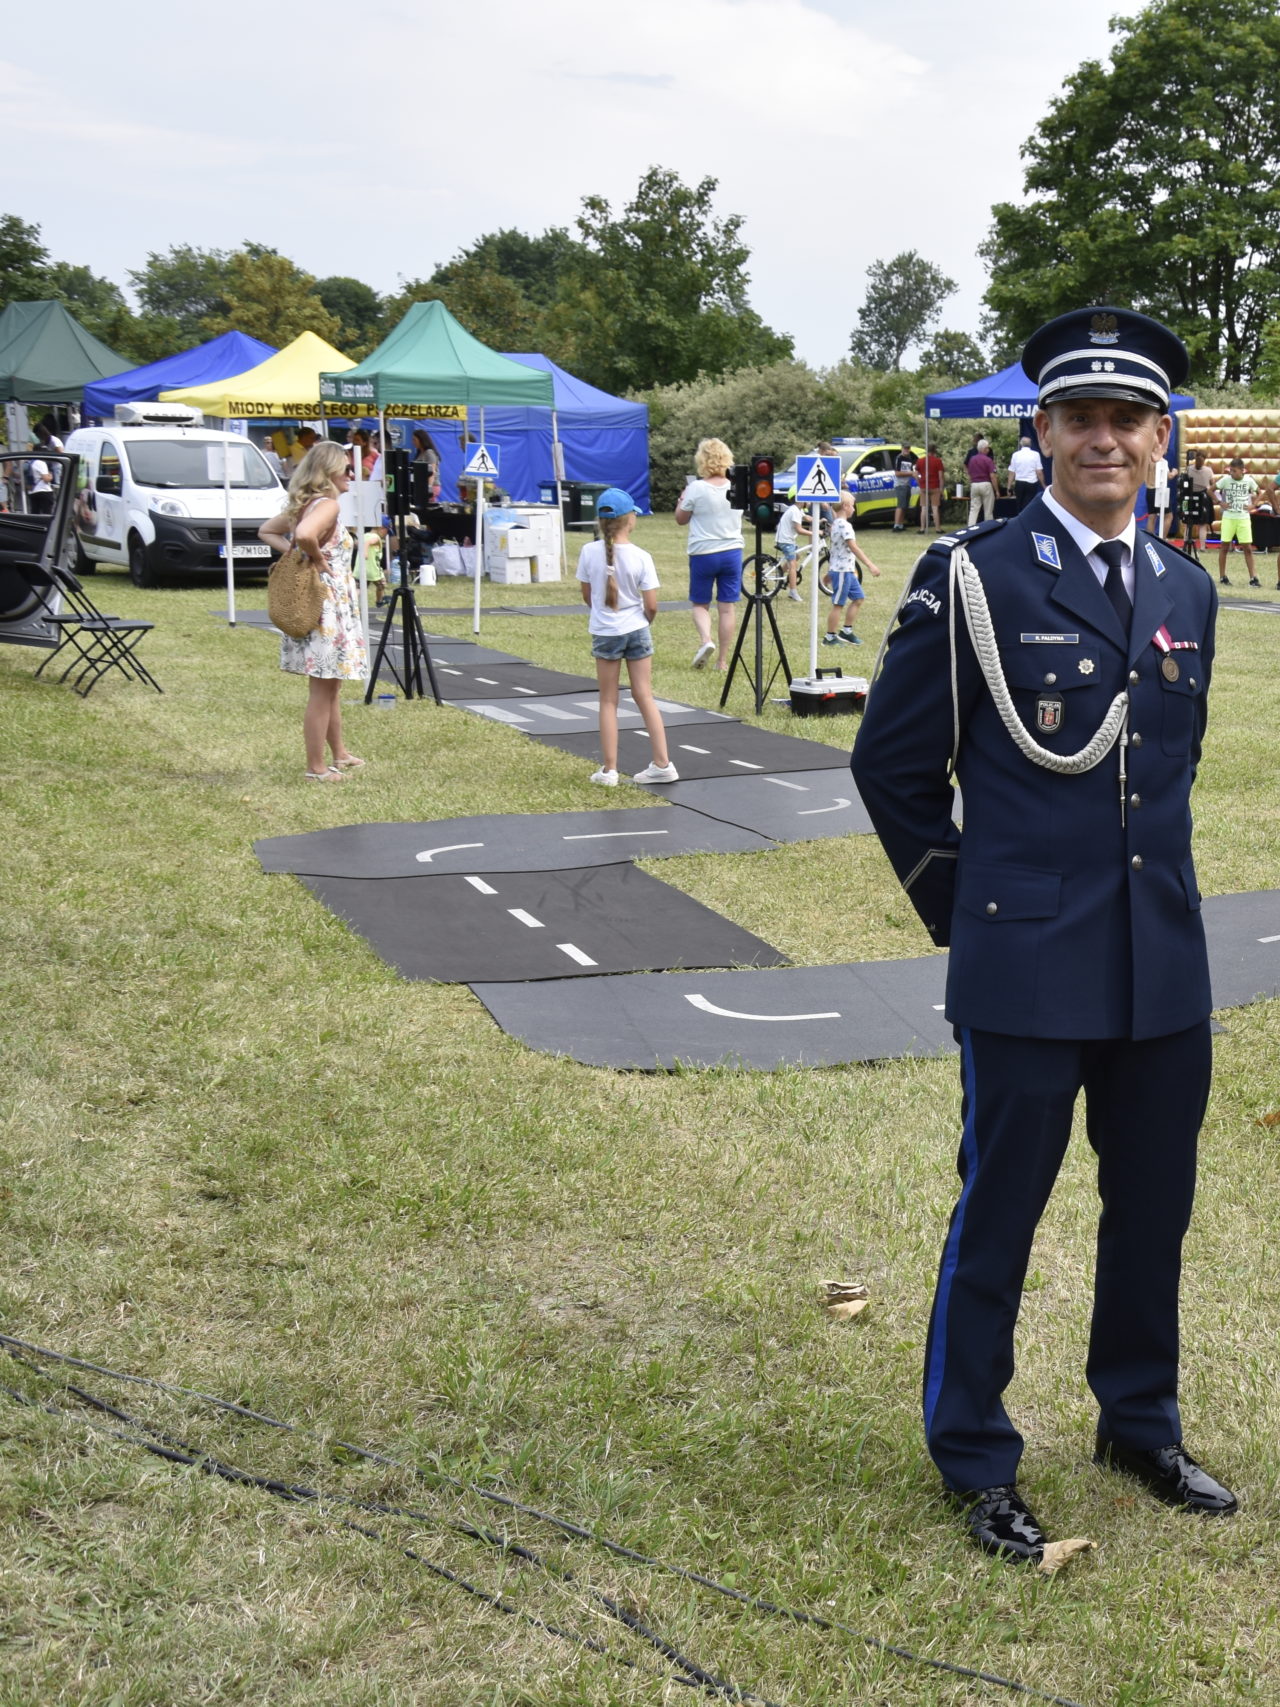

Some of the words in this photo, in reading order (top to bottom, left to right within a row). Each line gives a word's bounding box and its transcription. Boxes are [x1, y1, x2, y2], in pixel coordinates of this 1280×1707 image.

[228, 401, 274, 415] MIODY
[282, 402, 359, 416] WESOŁEGO
[983, 404, 1040, 418] POLICJA
[858, 479, 884, 490] POLICJA
[1230, 482, 1247, 490] THE
